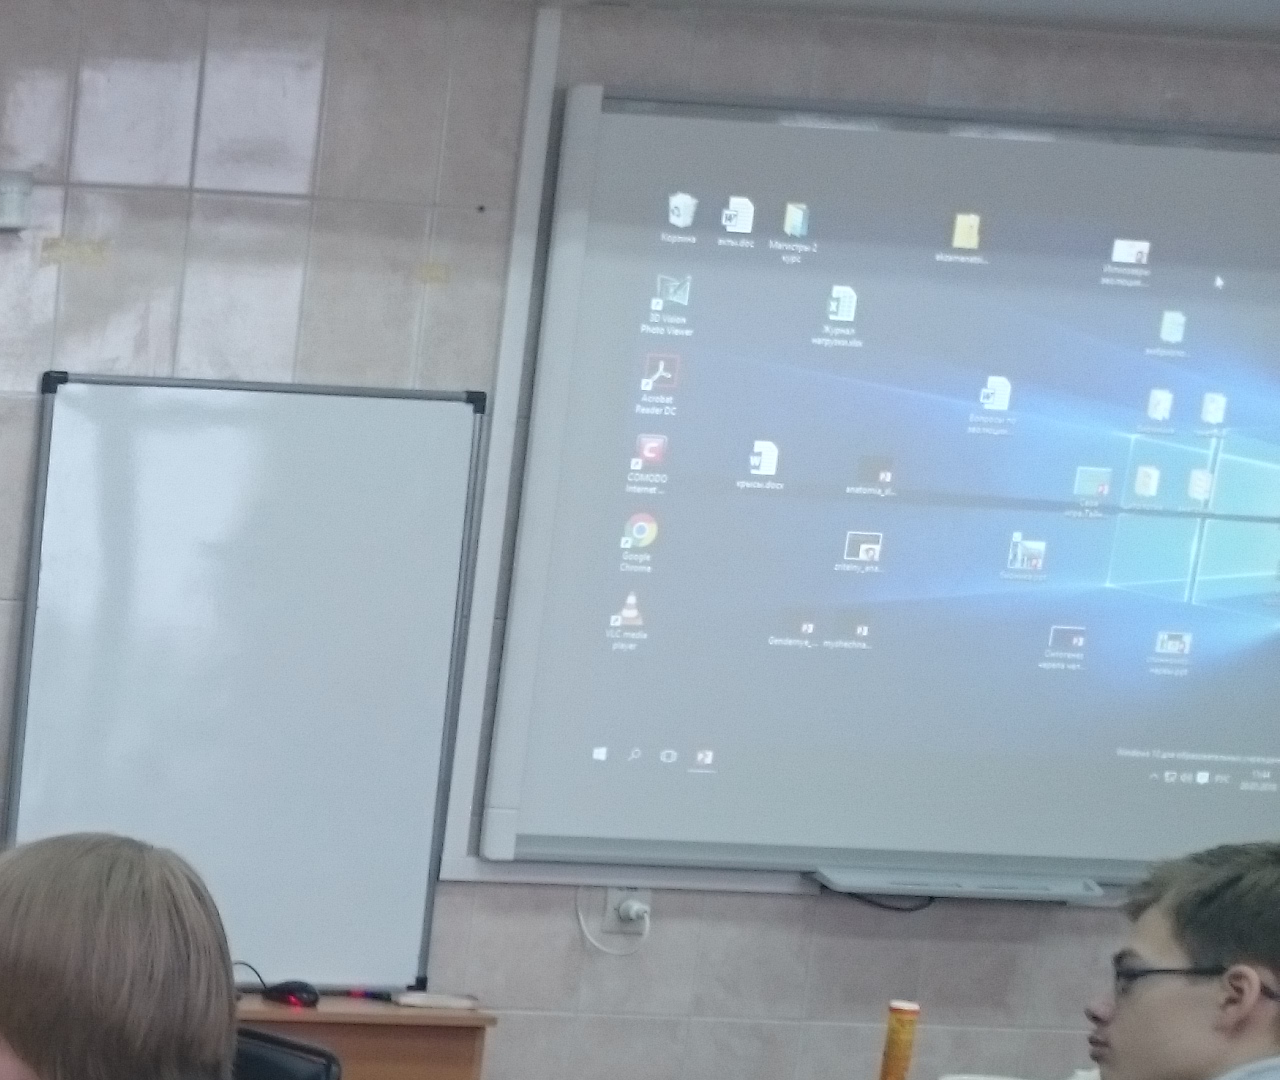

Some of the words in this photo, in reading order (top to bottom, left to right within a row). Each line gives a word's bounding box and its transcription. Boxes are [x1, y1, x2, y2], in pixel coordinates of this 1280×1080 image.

[661, 232, 696, 244] Корзина
[641, 324, 665, 335] Photo
[667, 327, 694, 336] Viewer
[641, 393, 673, 404] Acrobat
[636, 404, 663, 415] Reader
[664, 406, 677, 416] DC
[627, 472, 668, 483] COMODO
[626, 485, 657, 494] Internet
[622, 551, 651, 562] Google
[619, 562, 652, 573] Chrome
[605, 629, 620, 639] VLC
[622, 630, 648, 640] media
[612, 641, 637, 651] player
